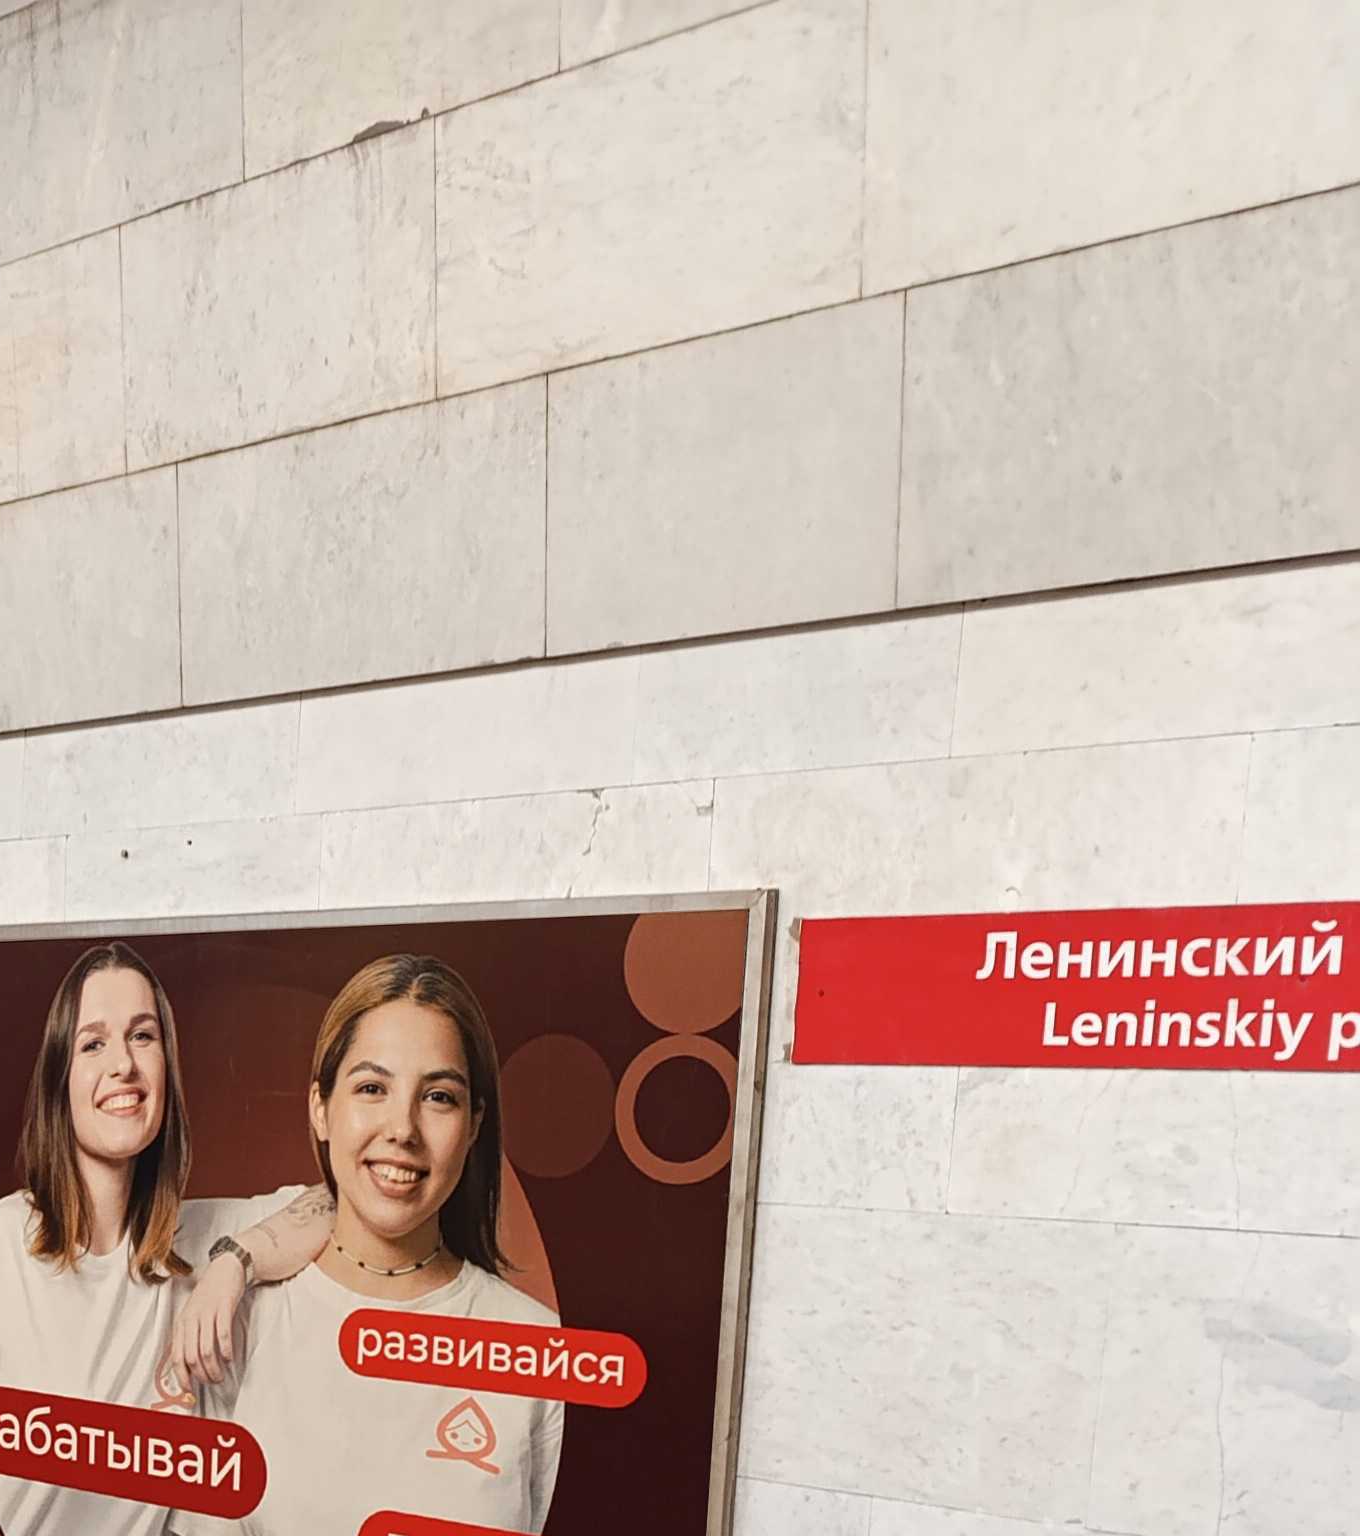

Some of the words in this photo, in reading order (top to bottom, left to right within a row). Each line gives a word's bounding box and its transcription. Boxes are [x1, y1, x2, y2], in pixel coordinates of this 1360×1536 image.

[976, 919, 1343, 979] Ленинский
[1042, 998, 1314, 1061] Leninskiy
[356, 1327, 625, 1387] развивайся
